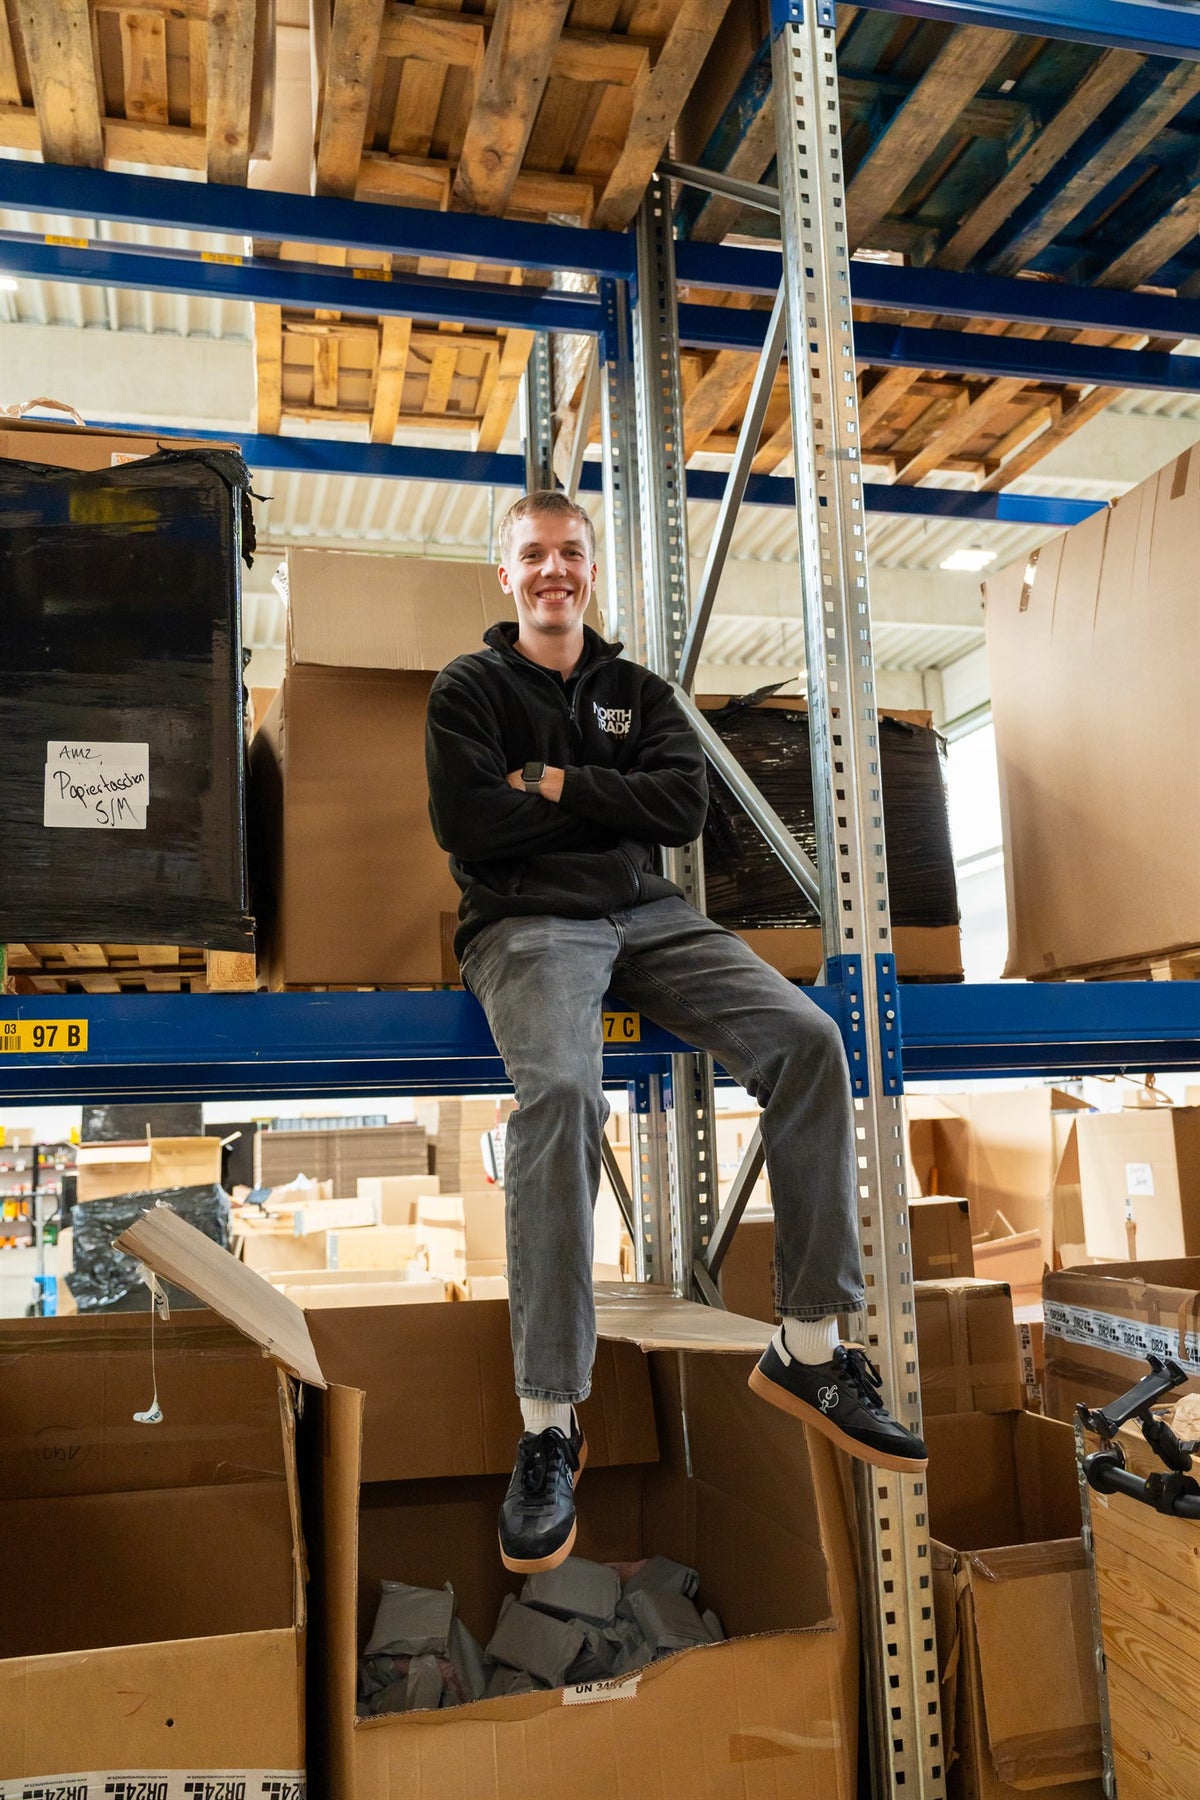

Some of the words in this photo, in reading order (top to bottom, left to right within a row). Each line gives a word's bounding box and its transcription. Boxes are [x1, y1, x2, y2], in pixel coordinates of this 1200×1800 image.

[593, 701, 632, 721] NORTH
[53, 770, 145, 809] Papiertaschen
[96, 797, 140, 827] S/M
[4, 1023, 17, 1035] 03
[32, 1025, 58, 1048] 97
[67, 1024, 81, 1047] B
[604, 1017, 616, 1038] 7
[623, 1016, 635, 1038] C
[575, 1684, 593, 1694] UN
[45, 1785, 88, 1800] DR24
[125, 1782, 168, 1800] DR24
[204, 1782, 247, 1800] DR24
